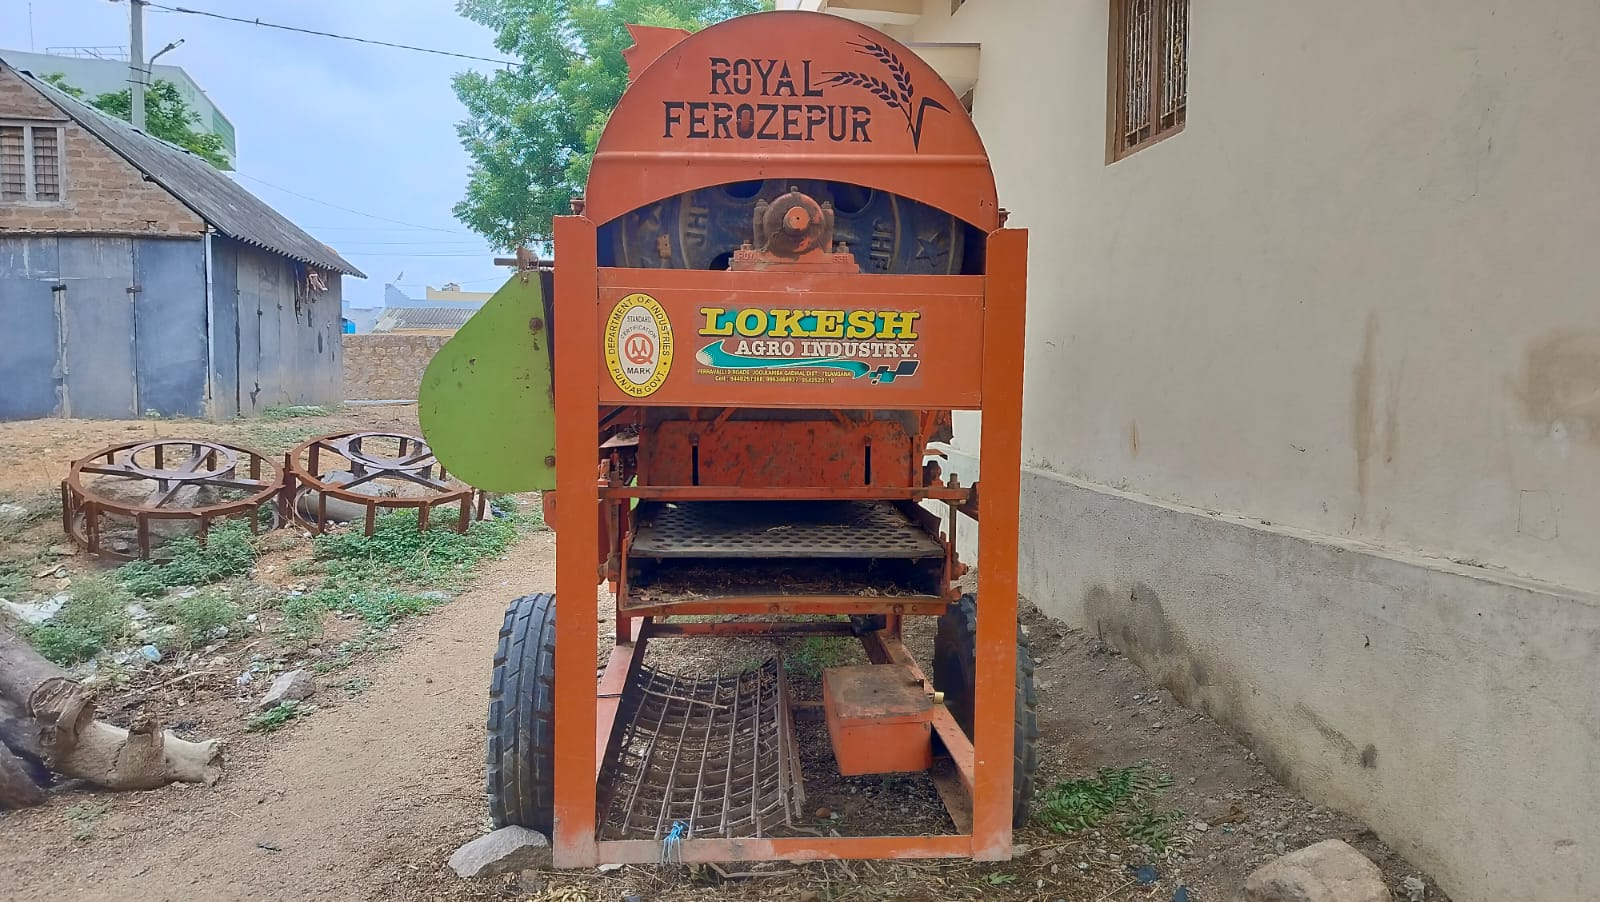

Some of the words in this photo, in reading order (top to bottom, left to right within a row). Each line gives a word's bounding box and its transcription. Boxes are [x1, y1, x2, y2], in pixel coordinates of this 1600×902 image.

[709, 57, 824, 97] ROYAL
[662, 101, 873, 142] FEROZEPUR
[607, 298, 633, 355] DEPARTMENT
[637, 296, 651, 305] OF
[651, 304, 671, 356] INDUSTRIES
[620, 325, 657, 340] CERTIFICATION
[626, 315, 652, 323] STANDARD
[698, 307, 920, 340] LOKESH
[734, 340, 795, 356] AGRO
[801, 341, 918, 358] INDUSTRY.
[613, 368, 642, 395] PUNJAB
[626, 367, 651, 375] MARK
